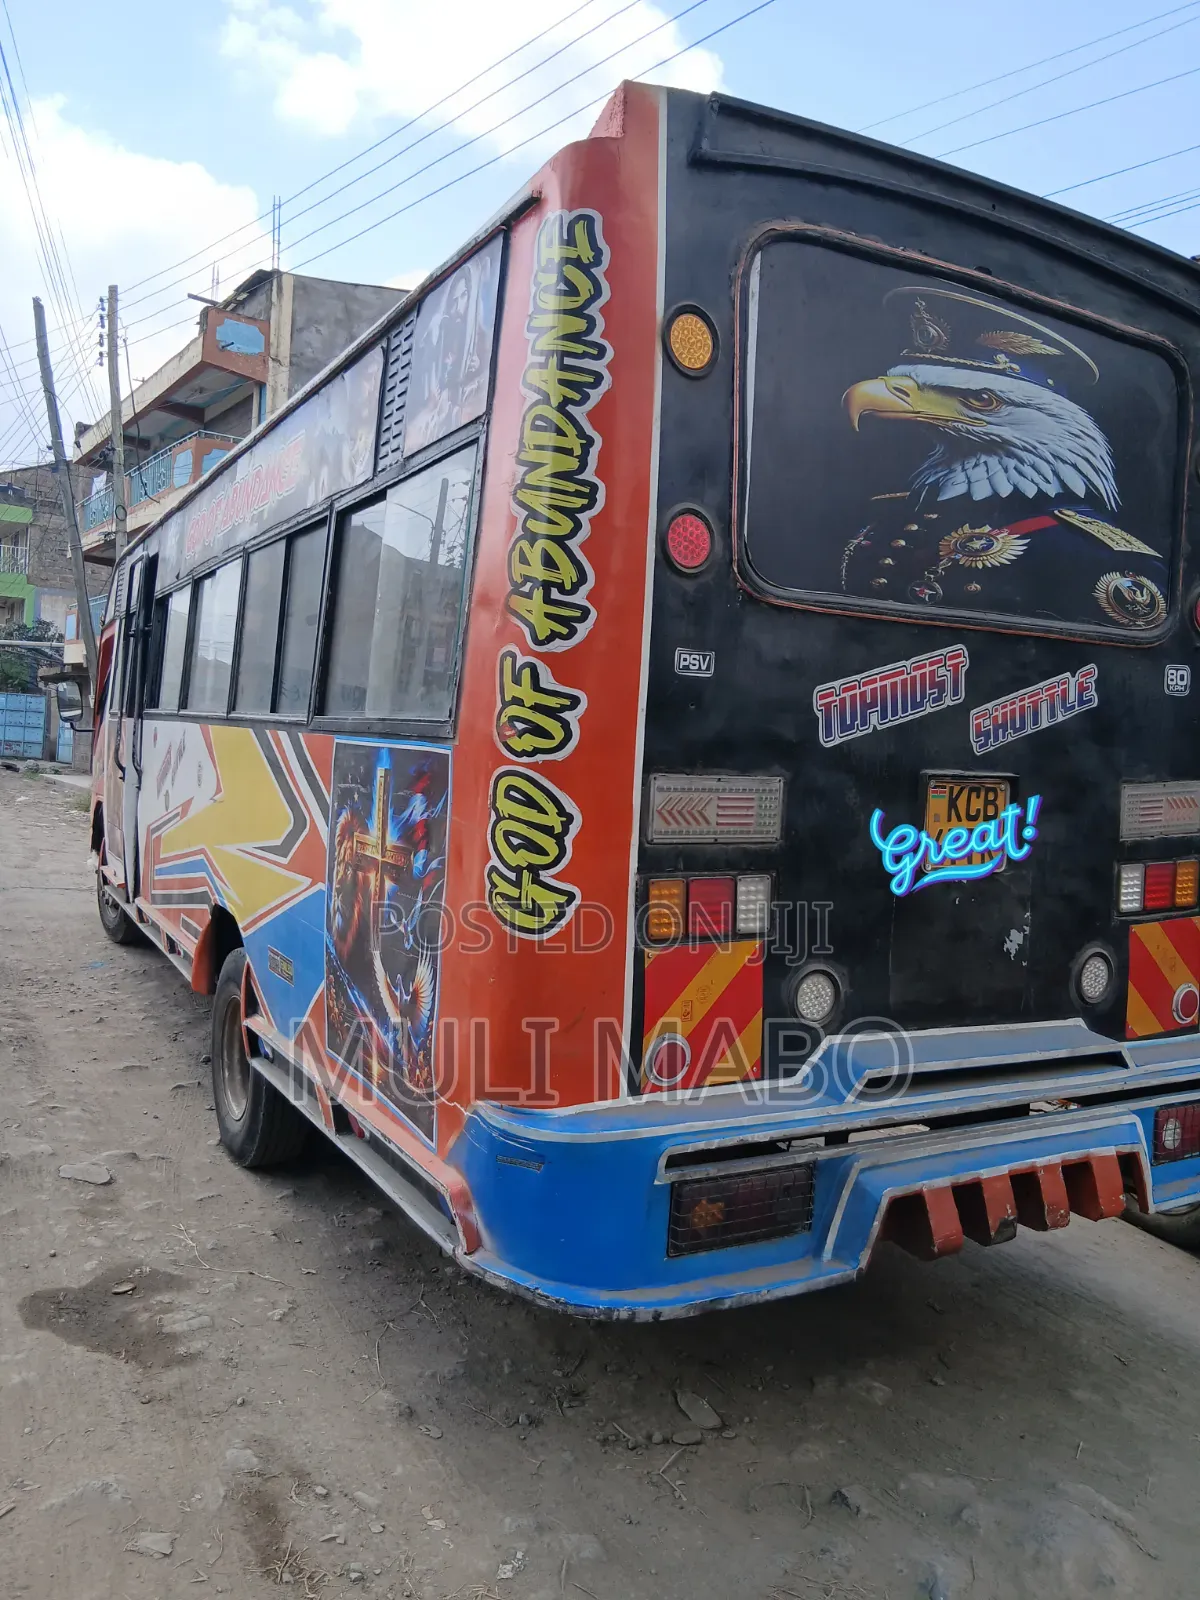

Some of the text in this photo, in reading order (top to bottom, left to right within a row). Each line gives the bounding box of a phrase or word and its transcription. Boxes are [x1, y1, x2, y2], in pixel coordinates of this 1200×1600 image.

[488, 213, 608, 937] GOD OF ABUNDANCE
[680, 653, 710, 670] PSV
[1168, 669, 1187, 686] 80
[1169, 684, 1185, 692] KPH
[815, 647, 1096, 753] TOPMOST SHUTTLE
[946, 784, 999, 823] KCB
